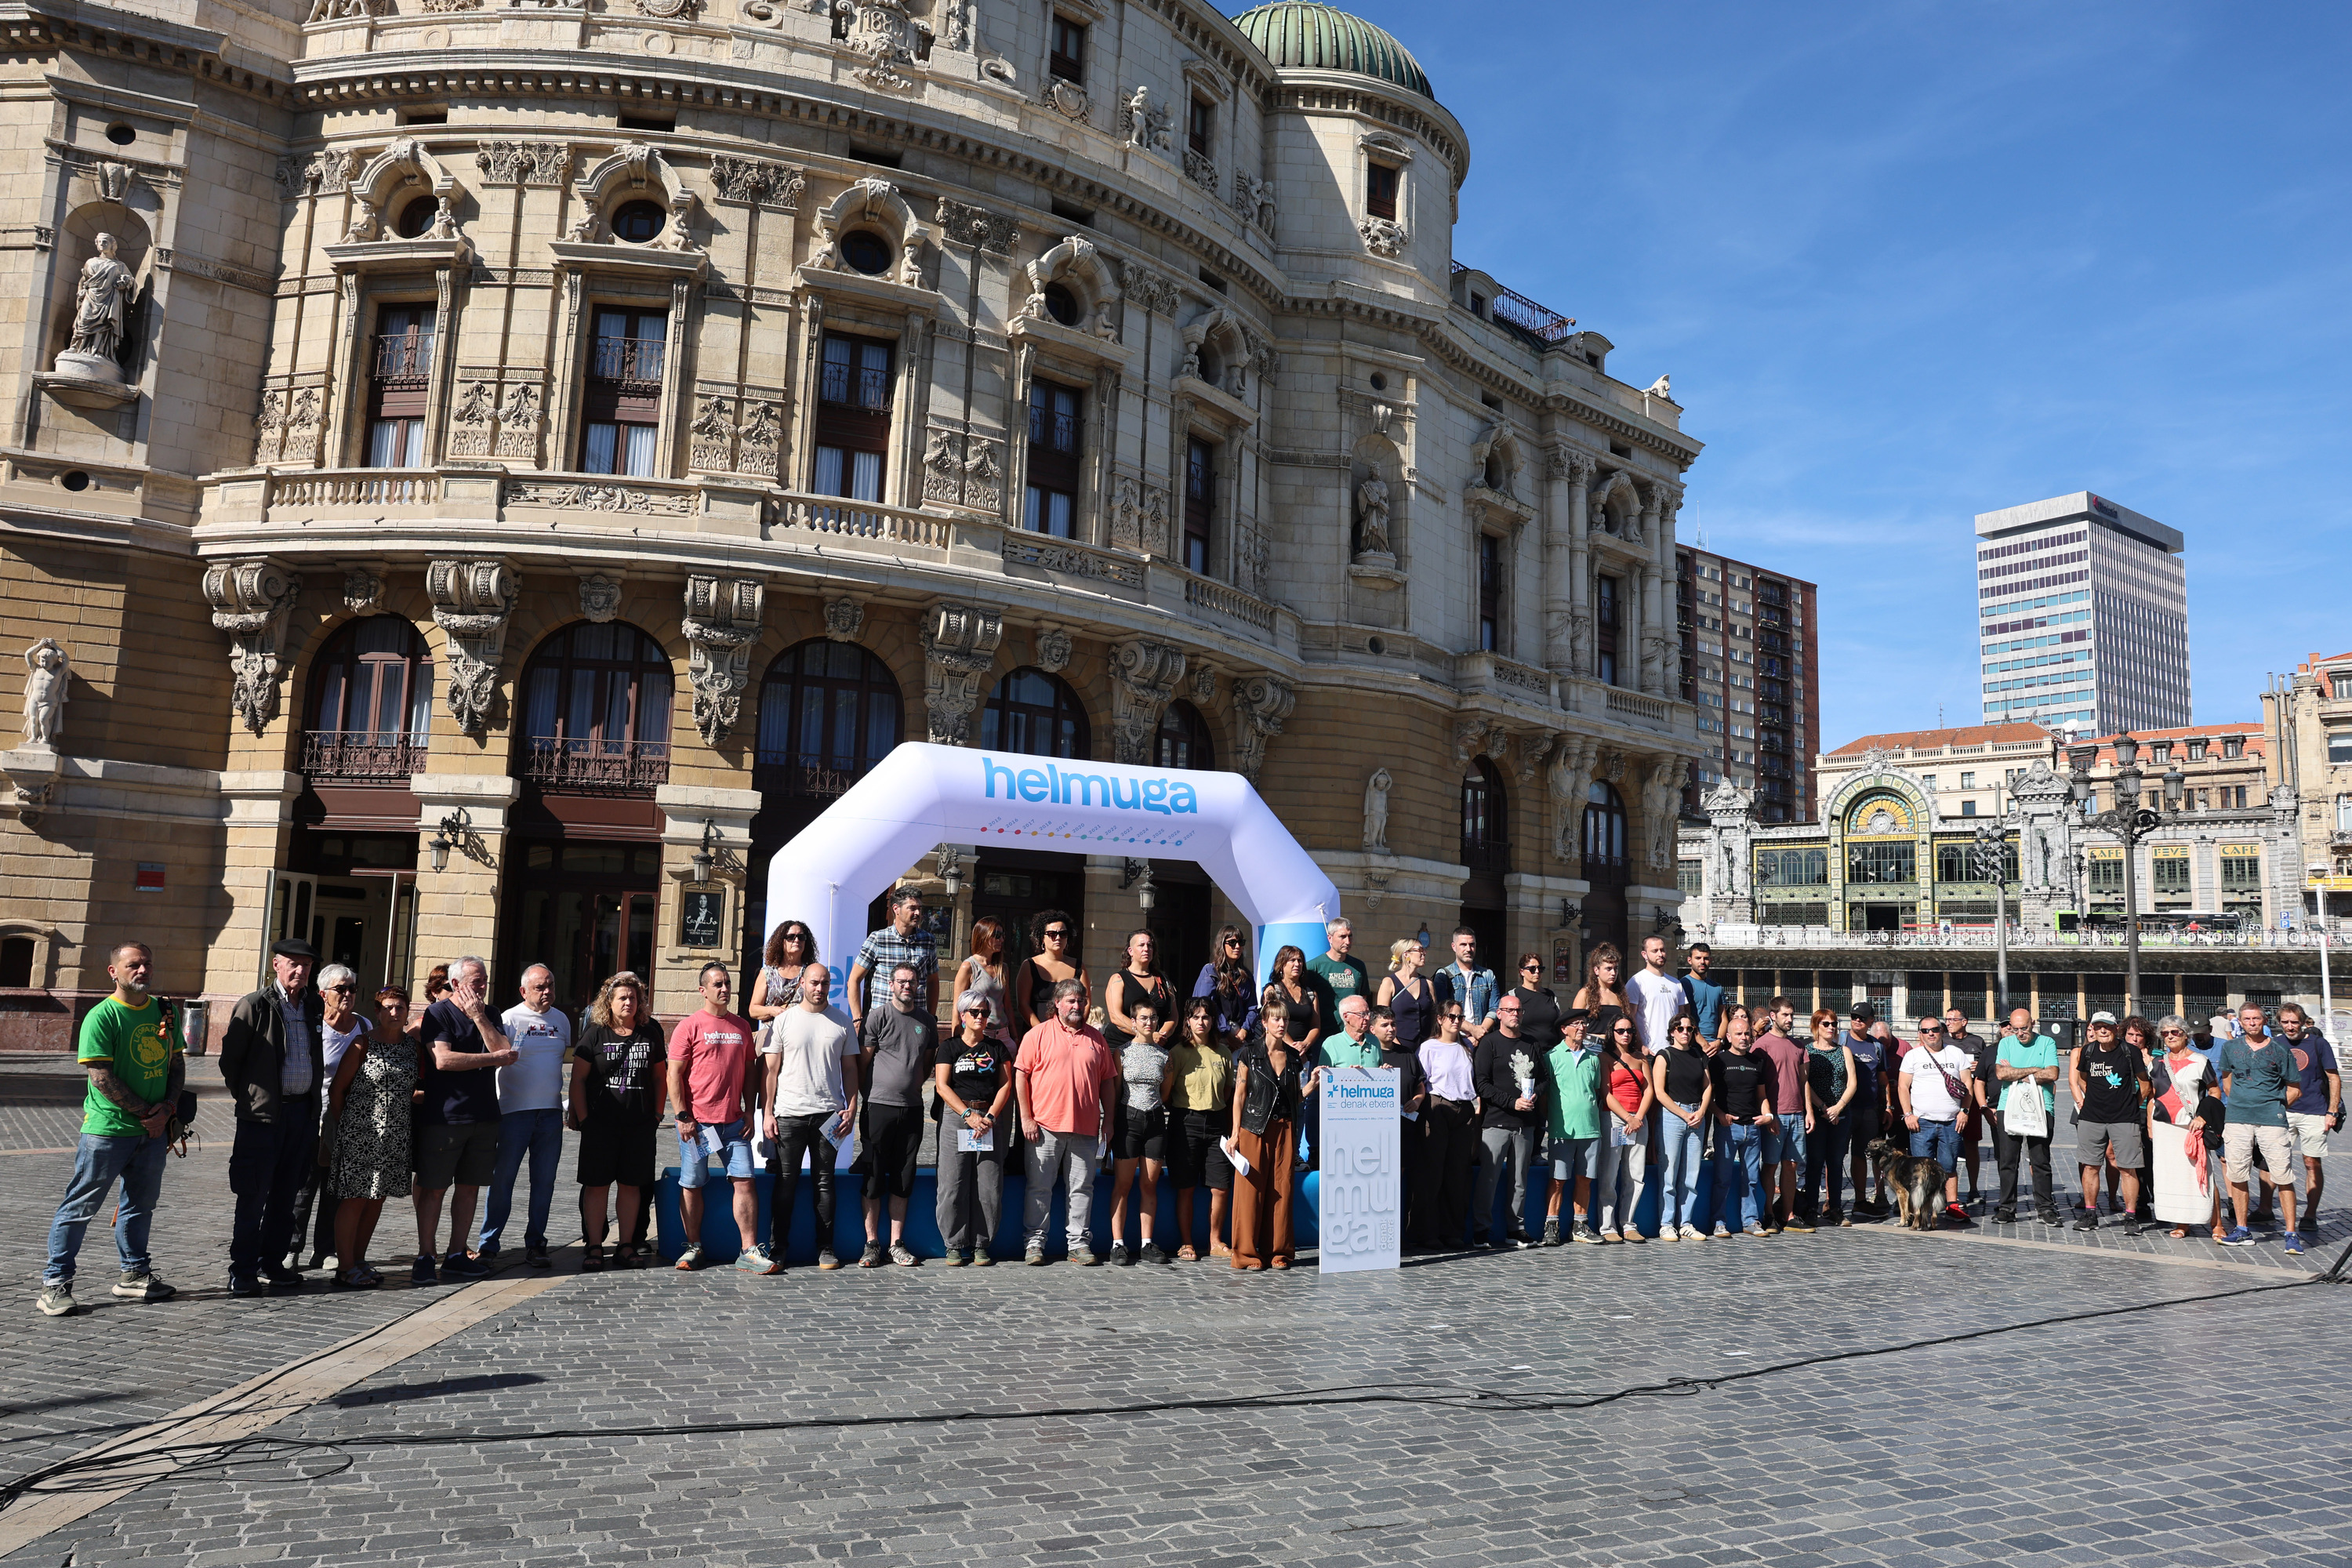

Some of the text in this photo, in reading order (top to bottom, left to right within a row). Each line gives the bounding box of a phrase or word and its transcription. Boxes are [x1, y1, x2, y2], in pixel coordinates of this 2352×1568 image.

[982, 757, 1197, 815] helmuga
[989, 816, 1002, 827] 2015
[1005, 818, 1018, 829] 2016
[1022, 818, 1035, 829] 2017
[1039, 820, 1052, 831] 2018
[1055, 822, 1069, 832] 2019
[1072, 823, 1085, 833] 2020
[1088, 824, 1102, 834] 2021
[1105, 825, 1117, 836] 2022
[1120, 826, 1133, 837] 2023
[1136, 828, 1149, 837] 2024
[1152, 829, 1165, 839] 2025
[1167, 829, 1181, 840] 2026
[1183, 830, 1196, 840] 2027
[2090, 849, 2122, 858] CAFE
[2154, 848, 2188, 857] FEVE
[2222, 845, 2258, 855] CAFE
[703, 1031, 742, 1040] helmuga
[143, 1069, 163, 1080] ZARE
[955, 1065, 975, 1073] gara
[1341, 1084, 1394, 1098] helmuga
[1341, 1099, 1368, 1109] denak
[1327, 1128, 1389, 1175] hel
[1327, 1178, 1395, 1214] mu
[1326, 1214, 1376, 1255] ga
